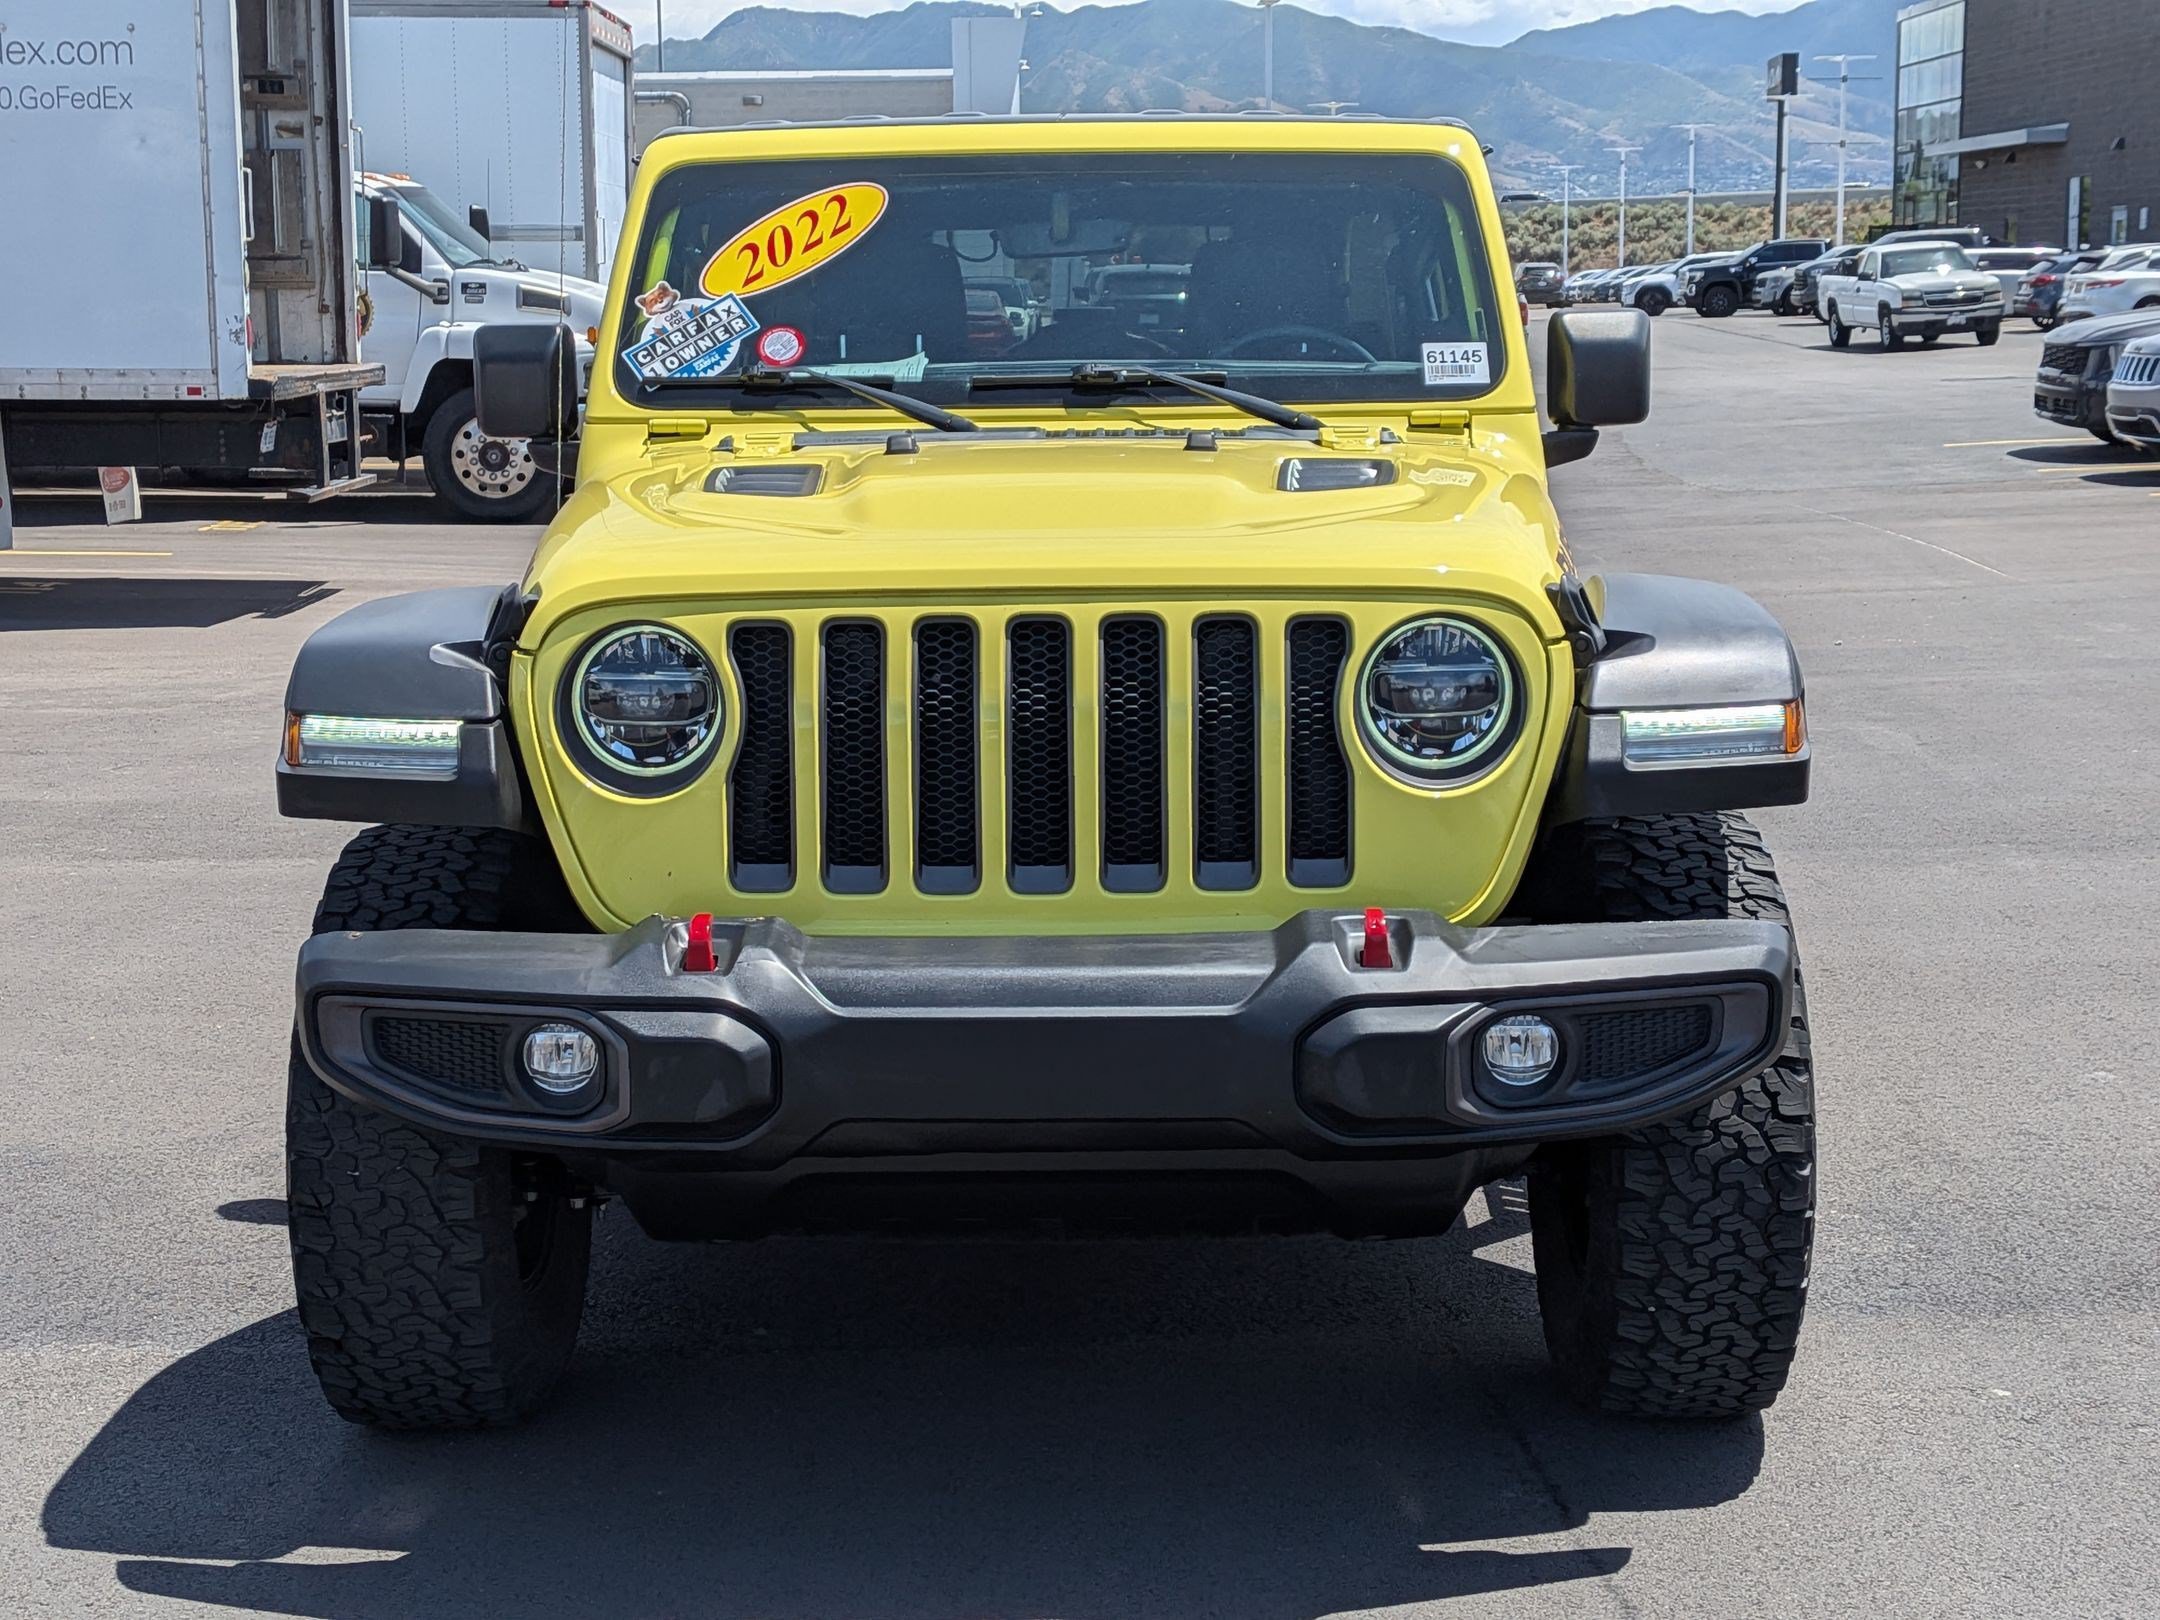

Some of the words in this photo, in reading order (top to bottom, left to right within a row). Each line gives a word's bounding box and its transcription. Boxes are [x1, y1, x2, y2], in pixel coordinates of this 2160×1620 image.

[0, 31, 133, 65] ex.com
[737, 194, 852, 288] 2022
[664, 309, 682, 322] CAR
[669, 315, 686, 328] FOX
[636, 304, 737, 364] CARFAX
[664, 317, 747, 370] OWNER
[1426, 349, 1483, 364] 61145
